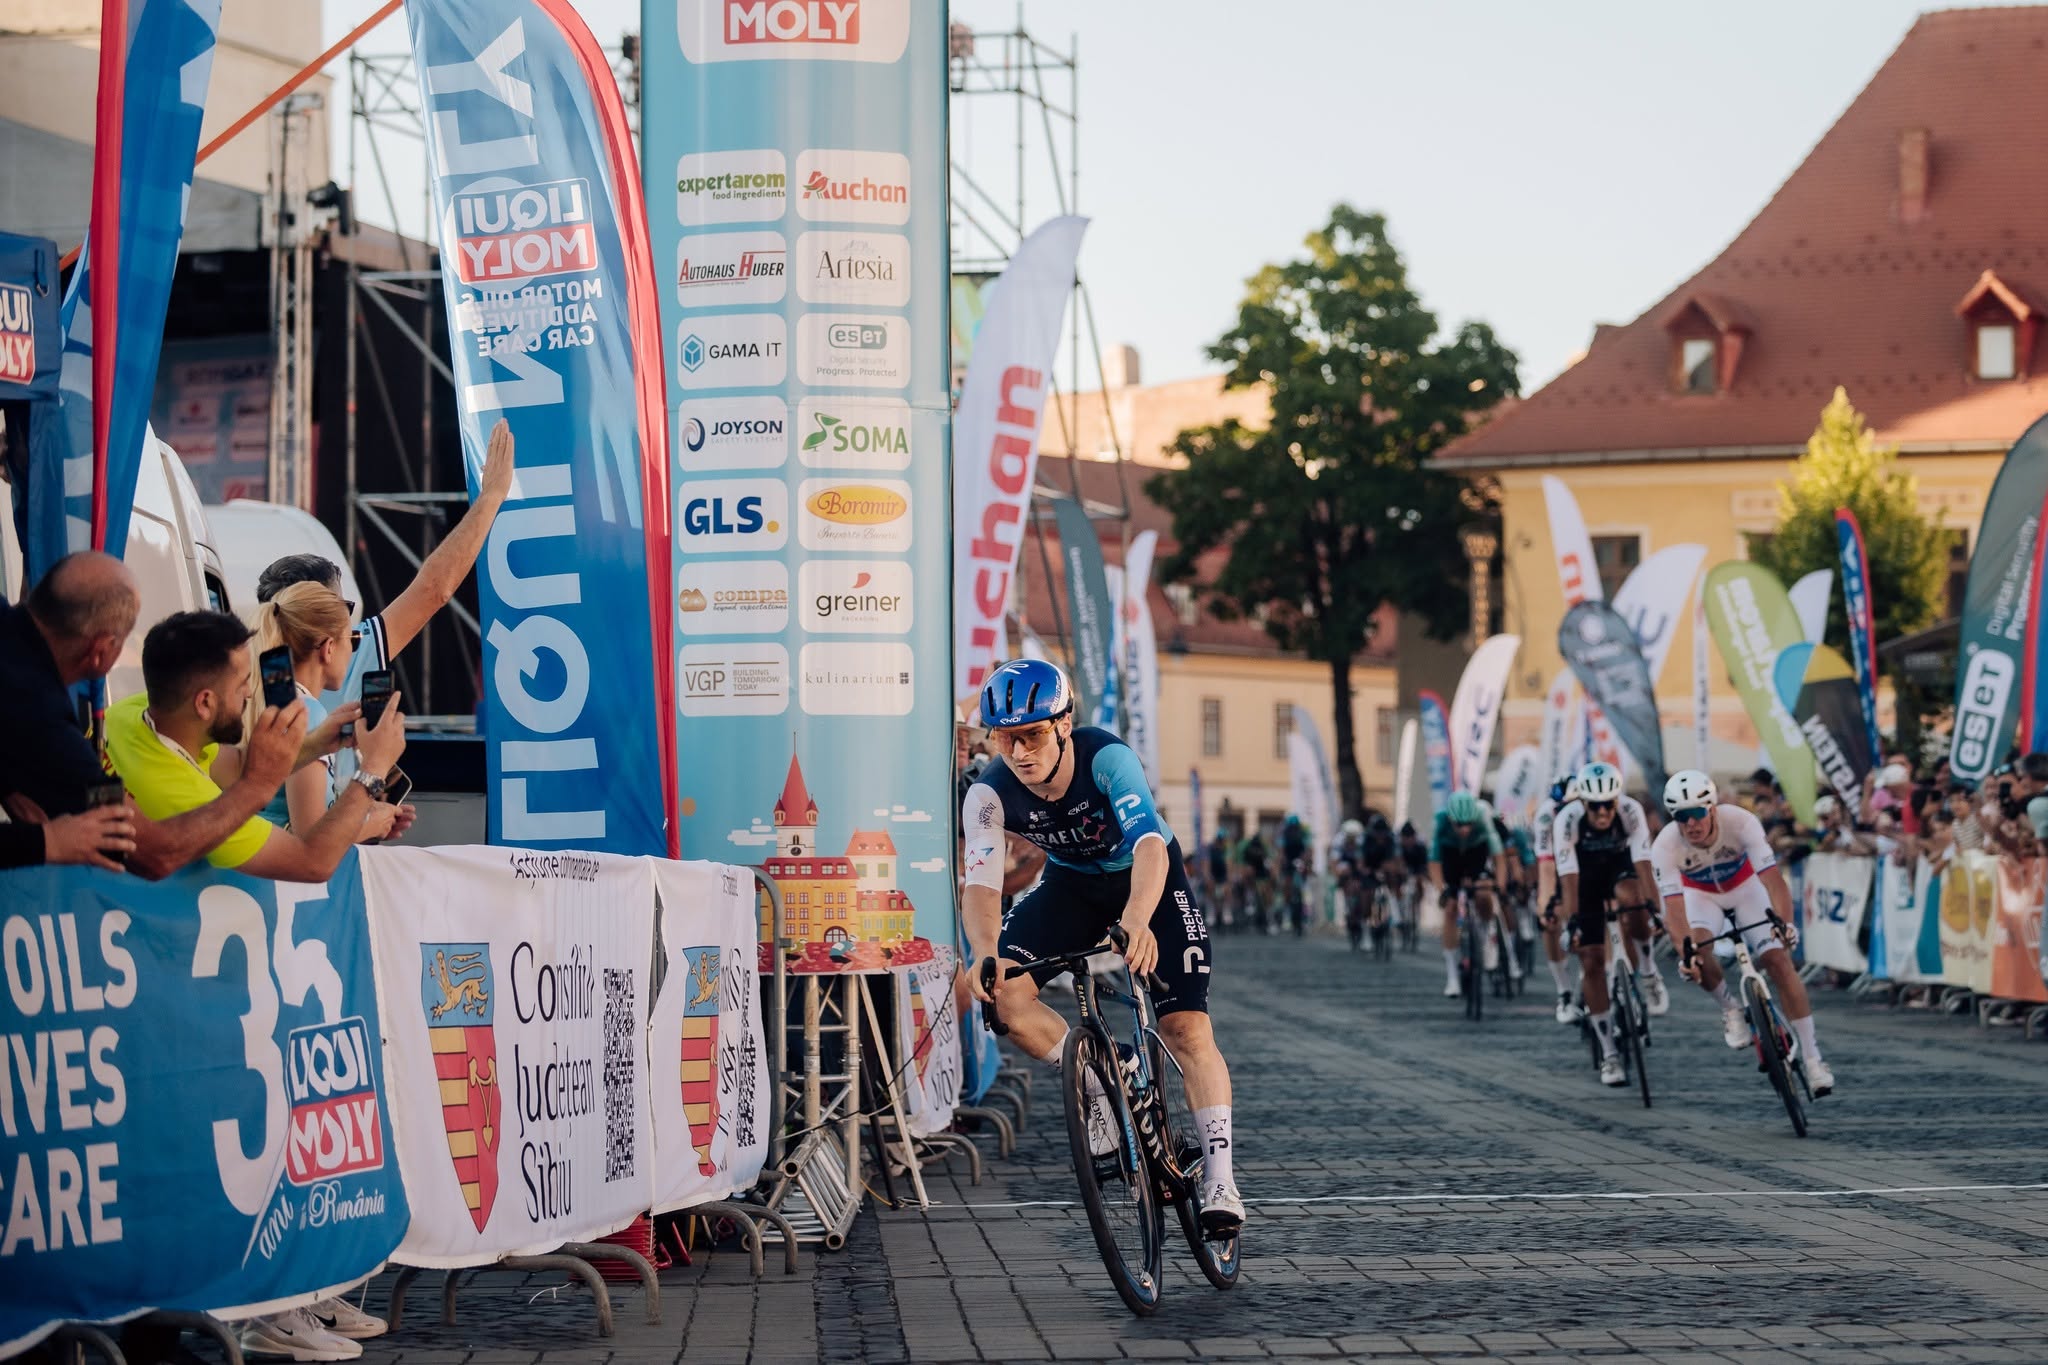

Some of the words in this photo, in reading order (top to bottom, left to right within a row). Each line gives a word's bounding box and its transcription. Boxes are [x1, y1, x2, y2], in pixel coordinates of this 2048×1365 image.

[730, 1, 858, 41] MOLY
[677, 173, 786, 196] expertarom
[712, 191, 731, 200] food
[733, 189, 786, 201] ingredients
[803, 171, 907, 204] Auchan
[816, 251, 897, 281] Artesia
[709, 343, 760, 359] GAMA
[765, 342, 782, 357] IT
[711, 420, 783, 436] JOYSON
[833, 425, 909, 454] SOMA
[817, 491, 899, 516] Boromir
[713, 589, 788, 604] compa
[816, 595, 901, 617] greiner
[685, 671, 726, 691] VGP
[805, 672, 895, 684] kulinarium
[1174, 889, 1194, 941] PREMIER
[1195, 908, 1208, 940] TECH
[3, 910, 137, 1016] OILS
[289, 1098, 376, 1175] MOLY
[520, 1141, 572, 1224] Sibiu
[0, 1142, 123, 1257] ARE
[260, 1182, 294, 1260] ani
